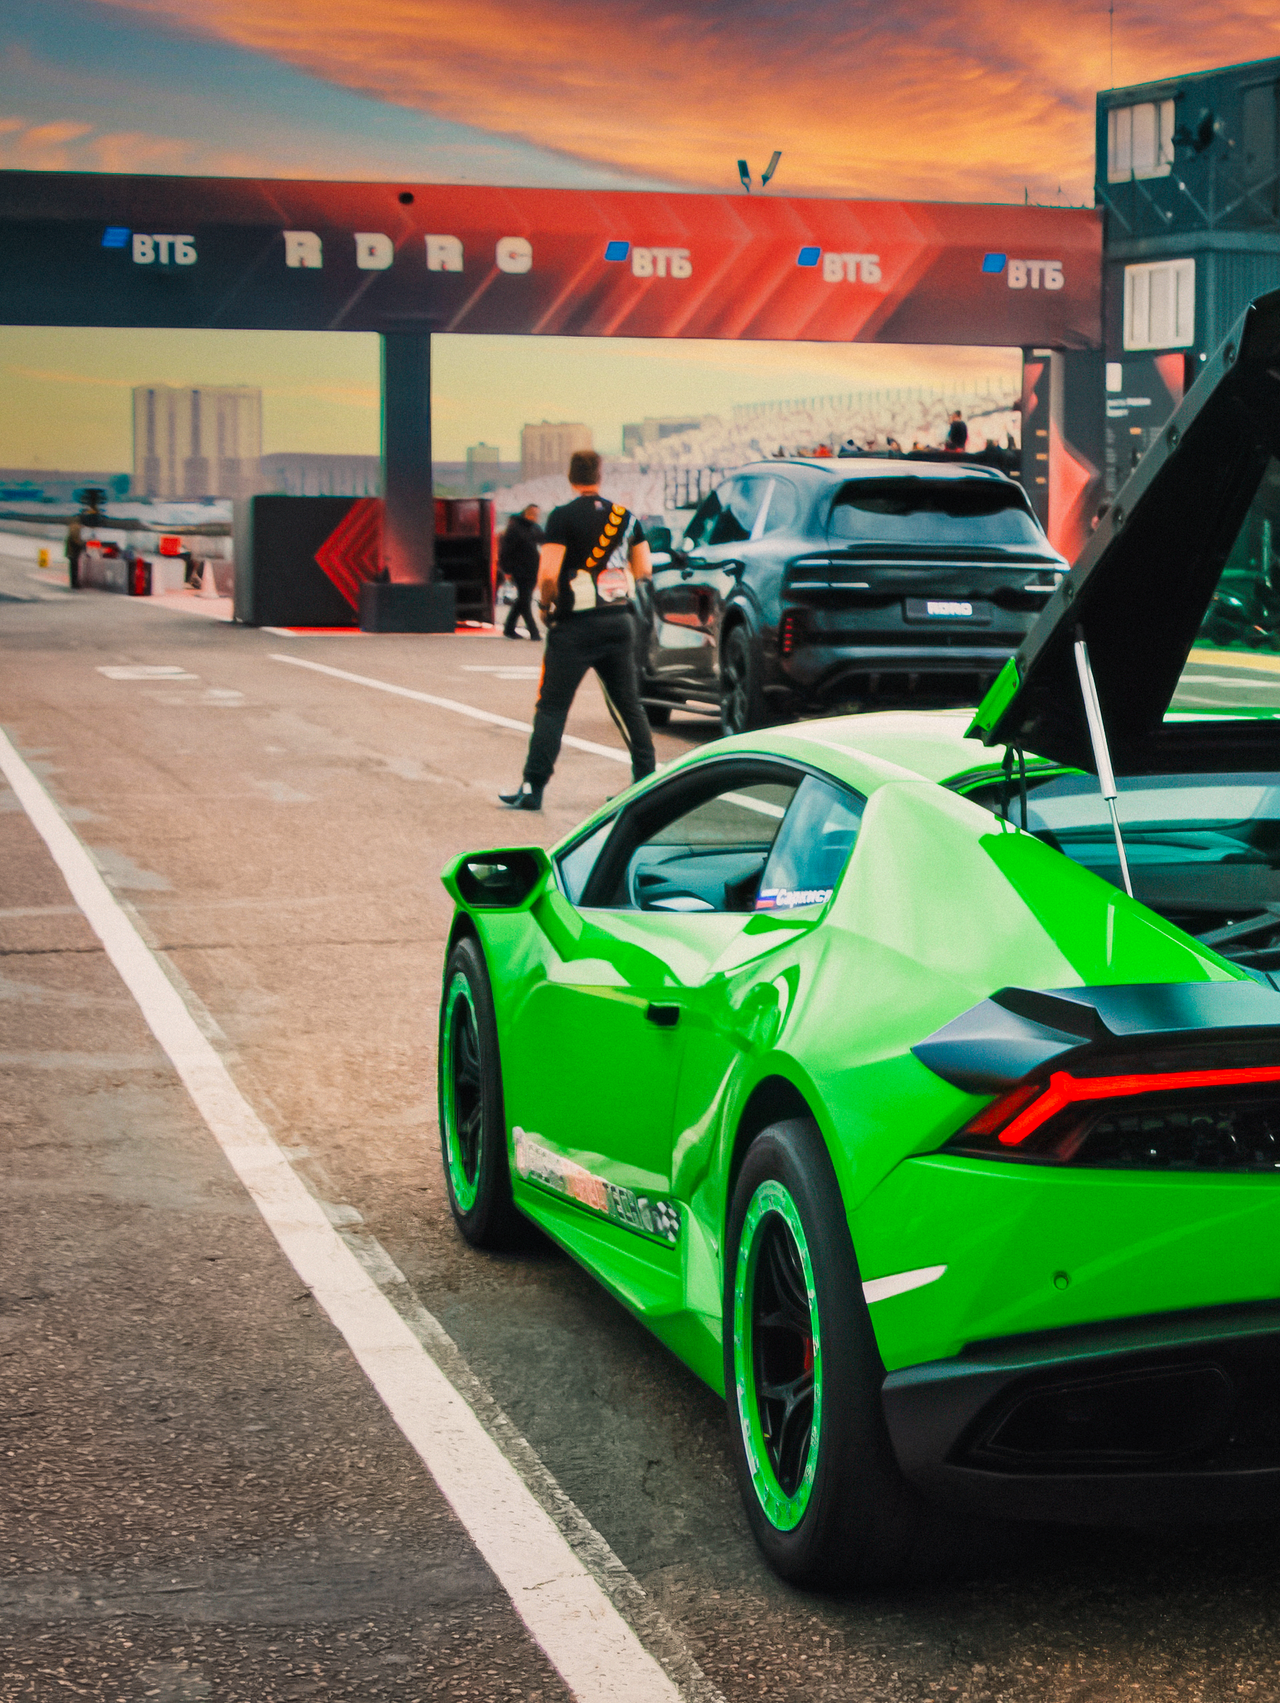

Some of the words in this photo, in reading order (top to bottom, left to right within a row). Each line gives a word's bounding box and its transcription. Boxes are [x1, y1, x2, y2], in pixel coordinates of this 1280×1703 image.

[132, 233, 198, 265] ВТБ
[631, 247, 693, 279] ВТБ
[822, 252, 882, 284] ВТБ
[1007, 259, 1065, 290] ВТБ
